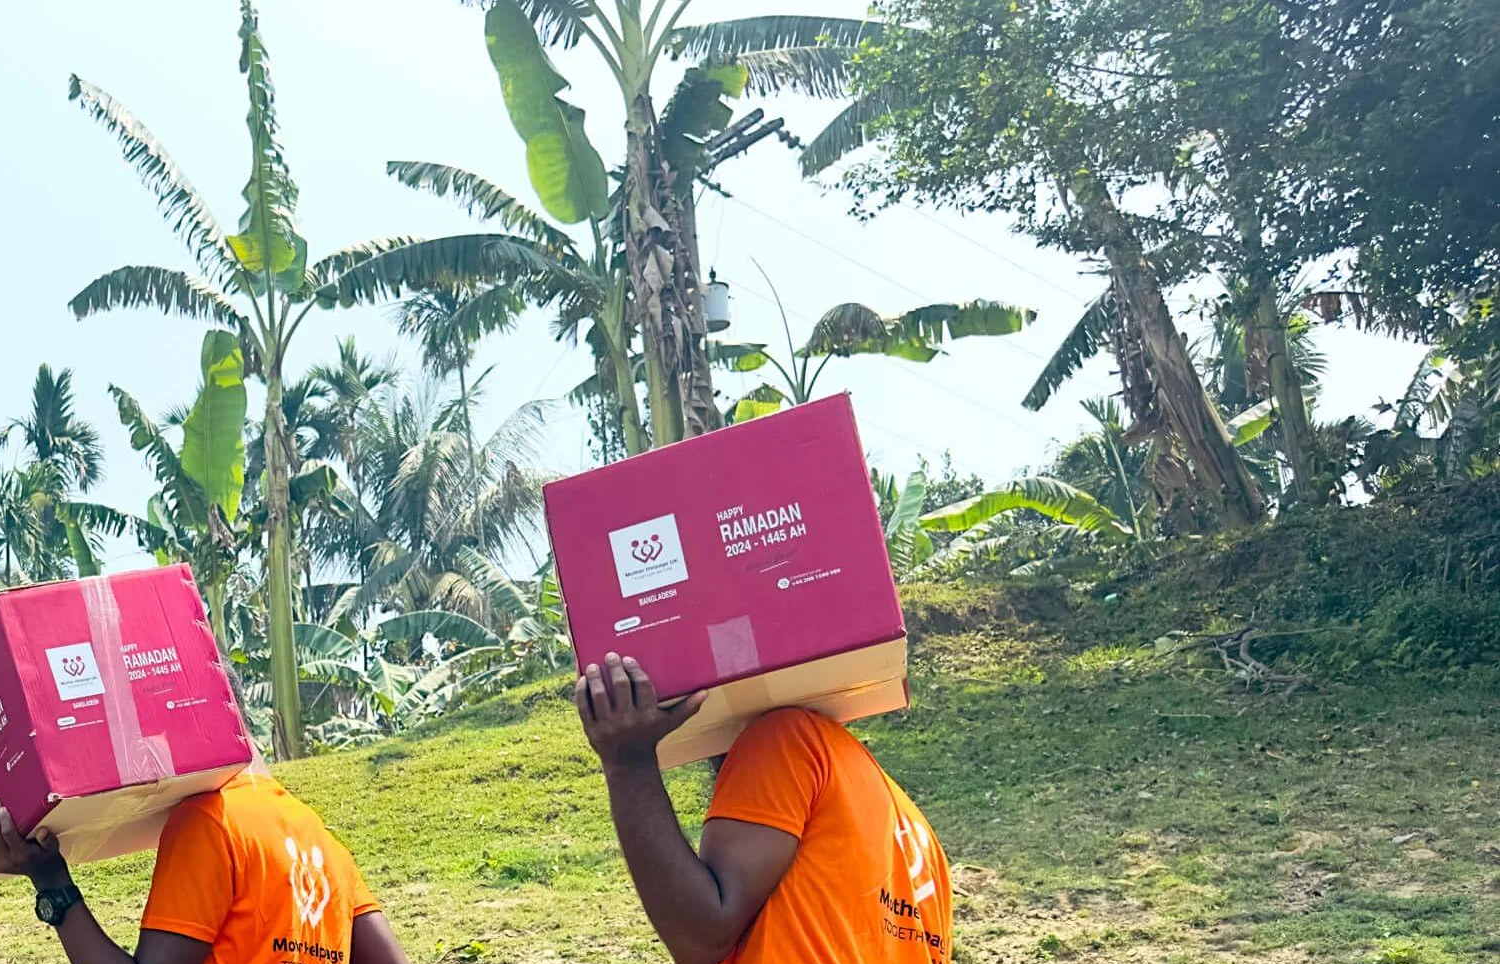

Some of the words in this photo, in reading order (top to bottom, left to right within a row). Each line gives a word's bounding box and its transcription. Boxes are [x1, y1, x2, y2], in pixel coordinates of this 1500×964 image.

[716, 505, 744, 522] HAPPY
[719, 502, 802, 543] RAMADAN
[725, 539, 752, 558] 2024
[761, 529, 788, 547] 1445
[790, 523, 807, 539] AH
[122, 646, 178, 669] RAMADAN
[128, 668, 147, 681] 2024
[151, 664, 169, 676] 1445
[170, 662, 182, 673] AH
